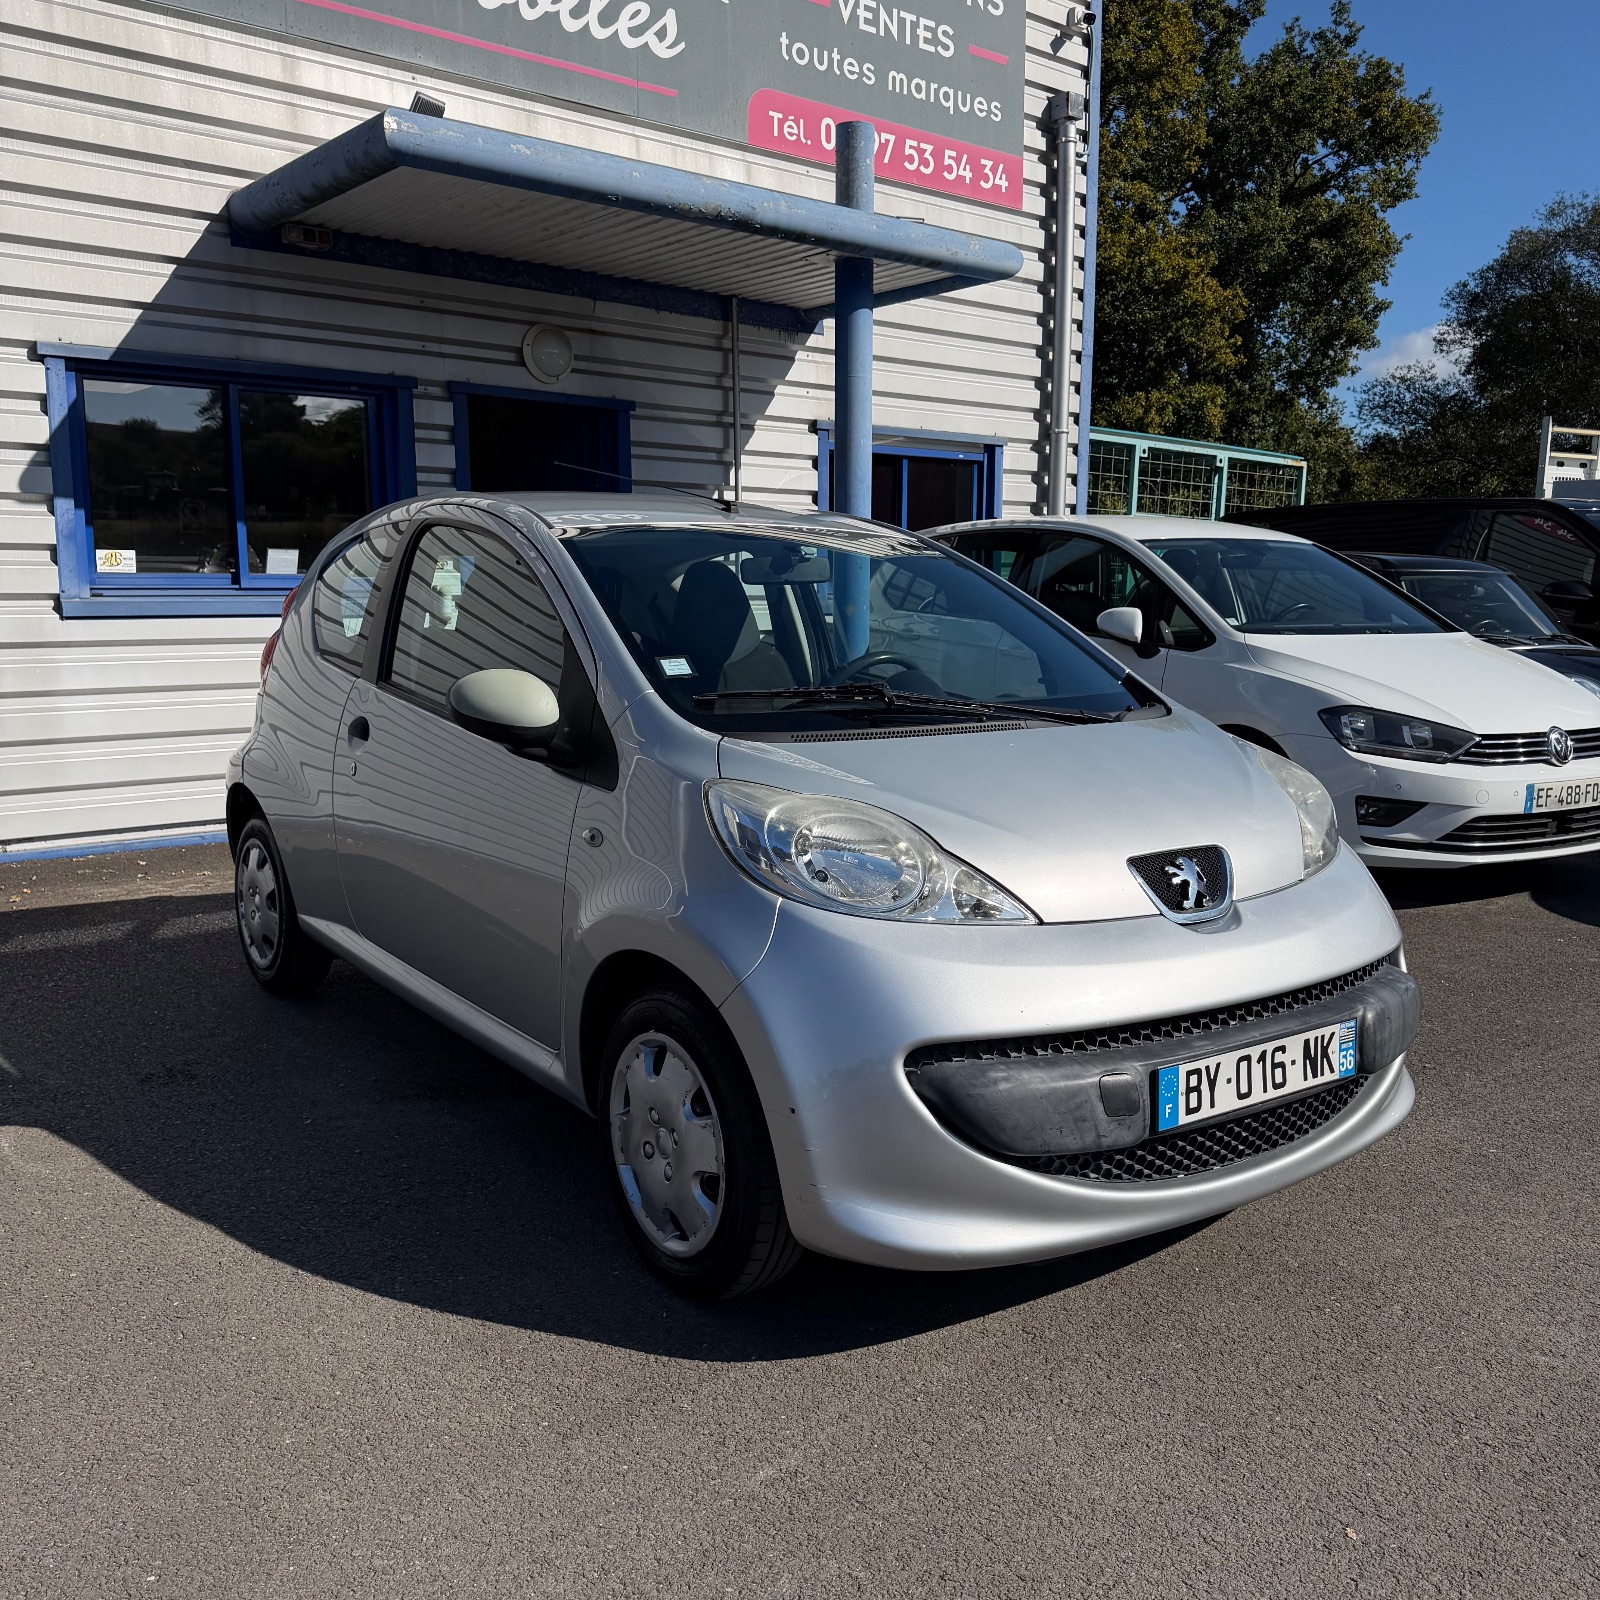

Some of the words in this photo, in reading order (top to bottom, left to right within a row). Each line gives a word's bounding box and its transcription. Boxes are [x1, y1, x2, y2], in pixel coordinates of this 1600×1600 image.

[838, 0, 955, 58] VENTES
[779, 31, 876, 86] toutes
[888, 70, 1002, 121] marques
[768, 110, 812, 146] Tél.
[820, 116, 836, 150] 0
[903, 138, 935, 175] 53
[943, 149, 973, 184] 54
[979, 158, 1008, 193] 34
[1165, 1103, 1173, 1119] F
[1184, 1031, 1337, 1117] BY-016-NK
[1339, 1049, 1355, 1072] 56
